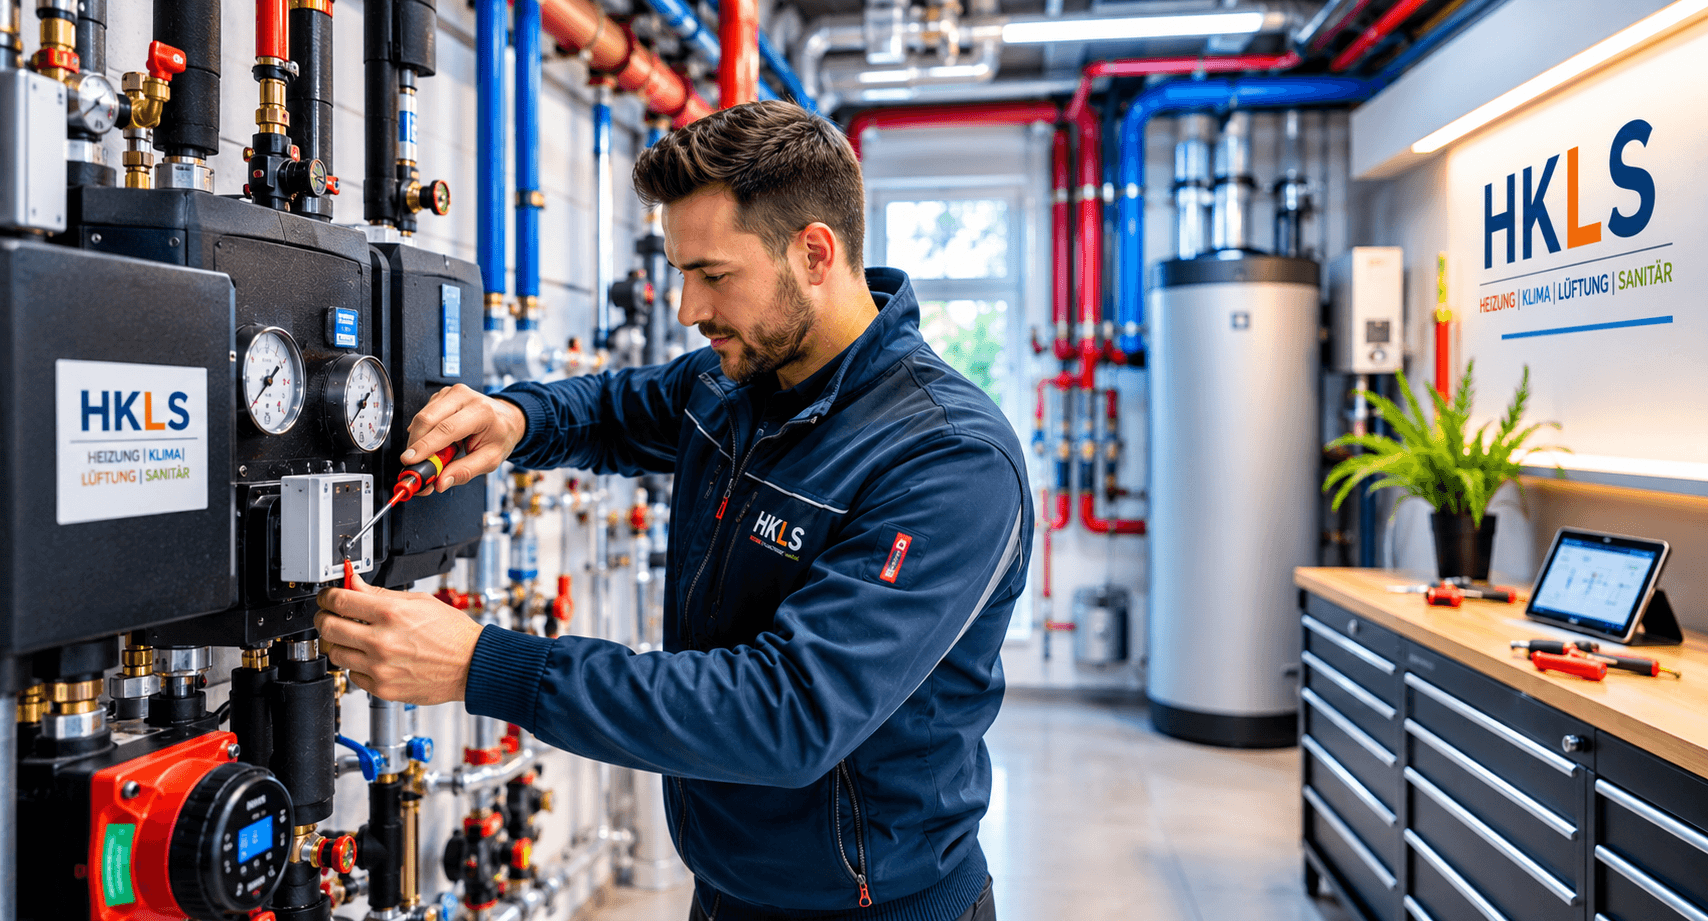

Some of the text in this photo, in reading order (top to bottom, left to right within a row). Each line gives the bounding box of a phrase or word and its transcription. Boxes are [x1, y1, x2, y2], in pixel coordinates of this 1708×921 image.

[1484, 119, 1656, 270] HKLS
[1479, 259, 1673, 314] HEIZUNG KLIMA LÜFTUNG SANITÄR
[81, 390, 190, 432] HKLS
[88, 448, 182, 464] HEIZUNG KLIMA
[81, 469, 136, 487] LÜFTUNG
[752, 510, 805, 552] HKLS
